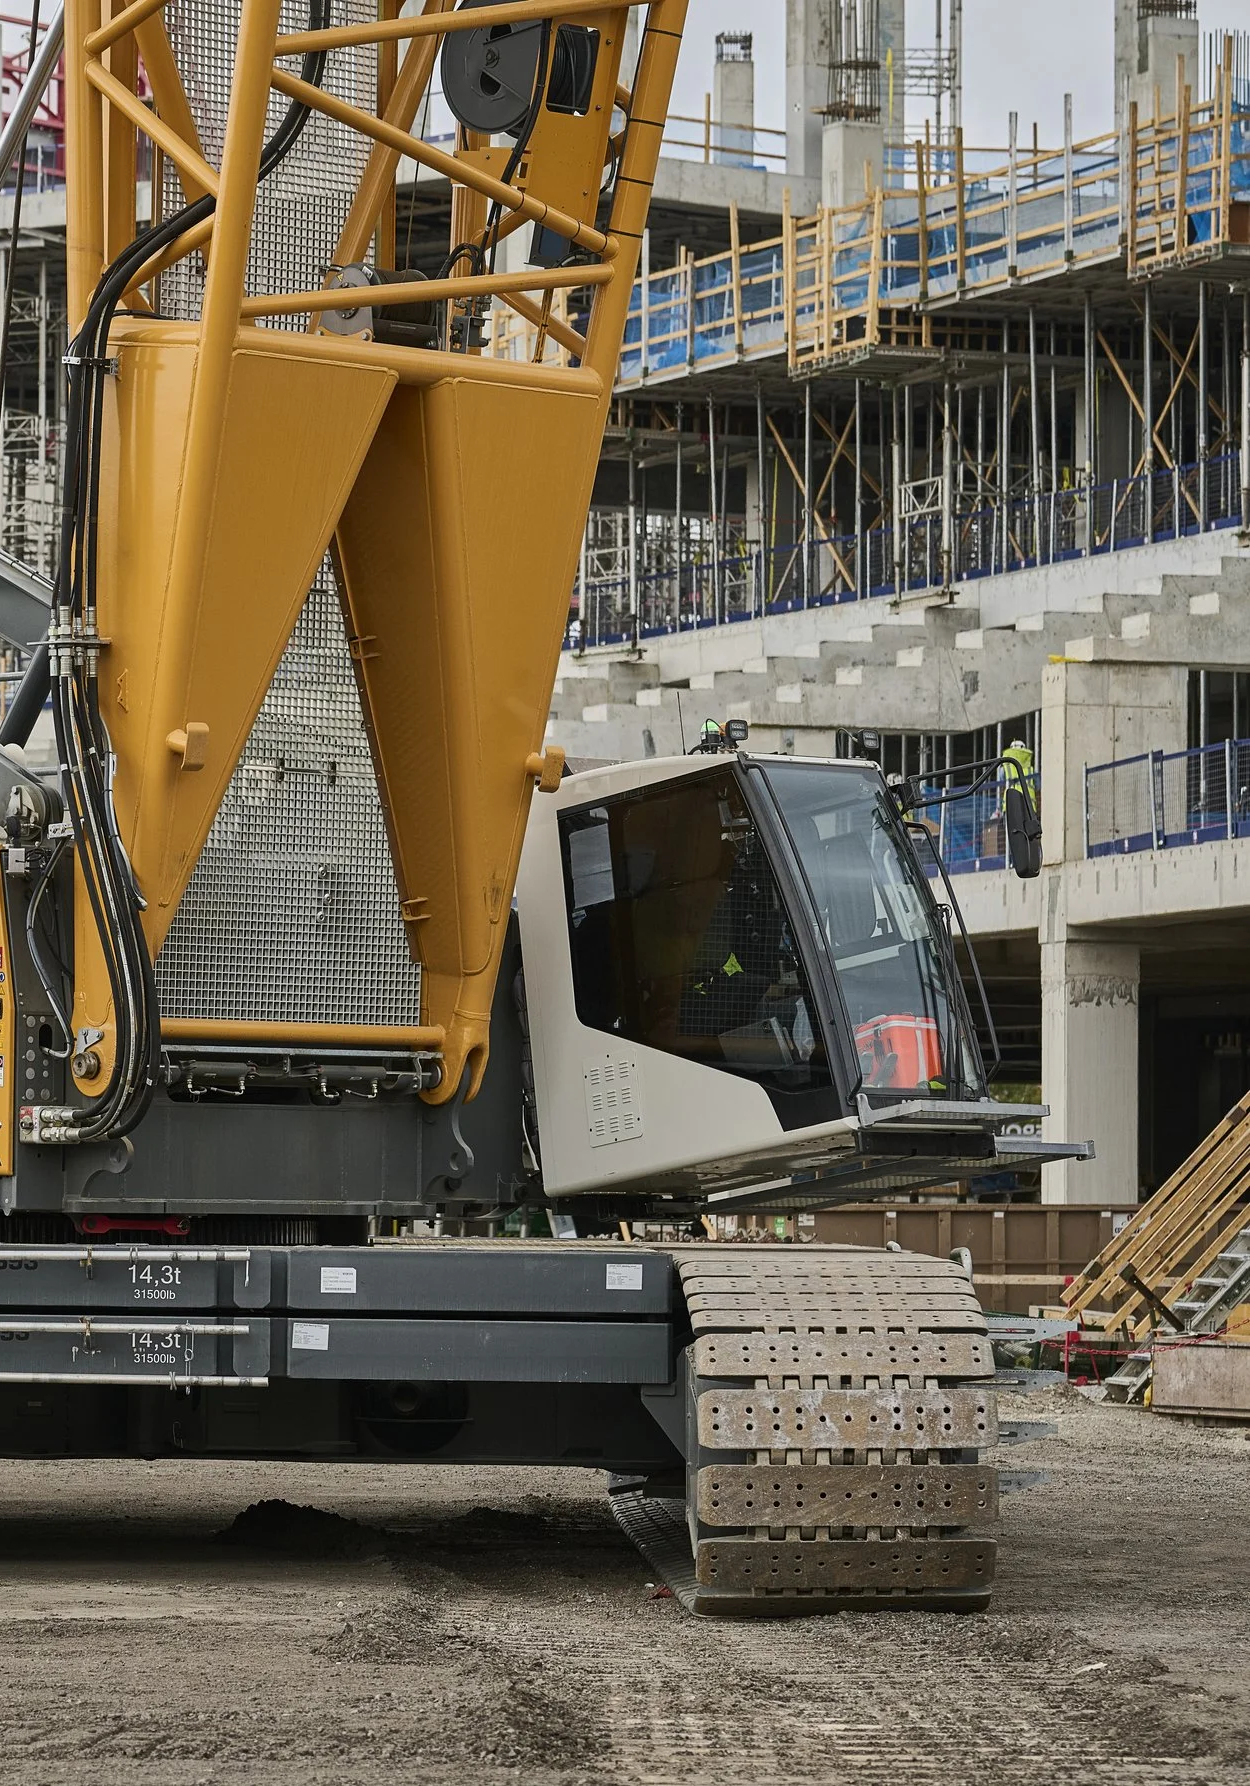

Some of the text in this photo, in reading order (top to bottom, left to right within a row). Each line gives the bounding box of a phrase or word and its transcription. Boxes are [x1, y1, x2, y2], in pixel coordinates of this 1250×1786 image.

[128, 1264, 182, 1287] 14,3t
[133, 1289, 176, 1300] 31500lb
[133, 1353, 176, 1364] 31500lb
